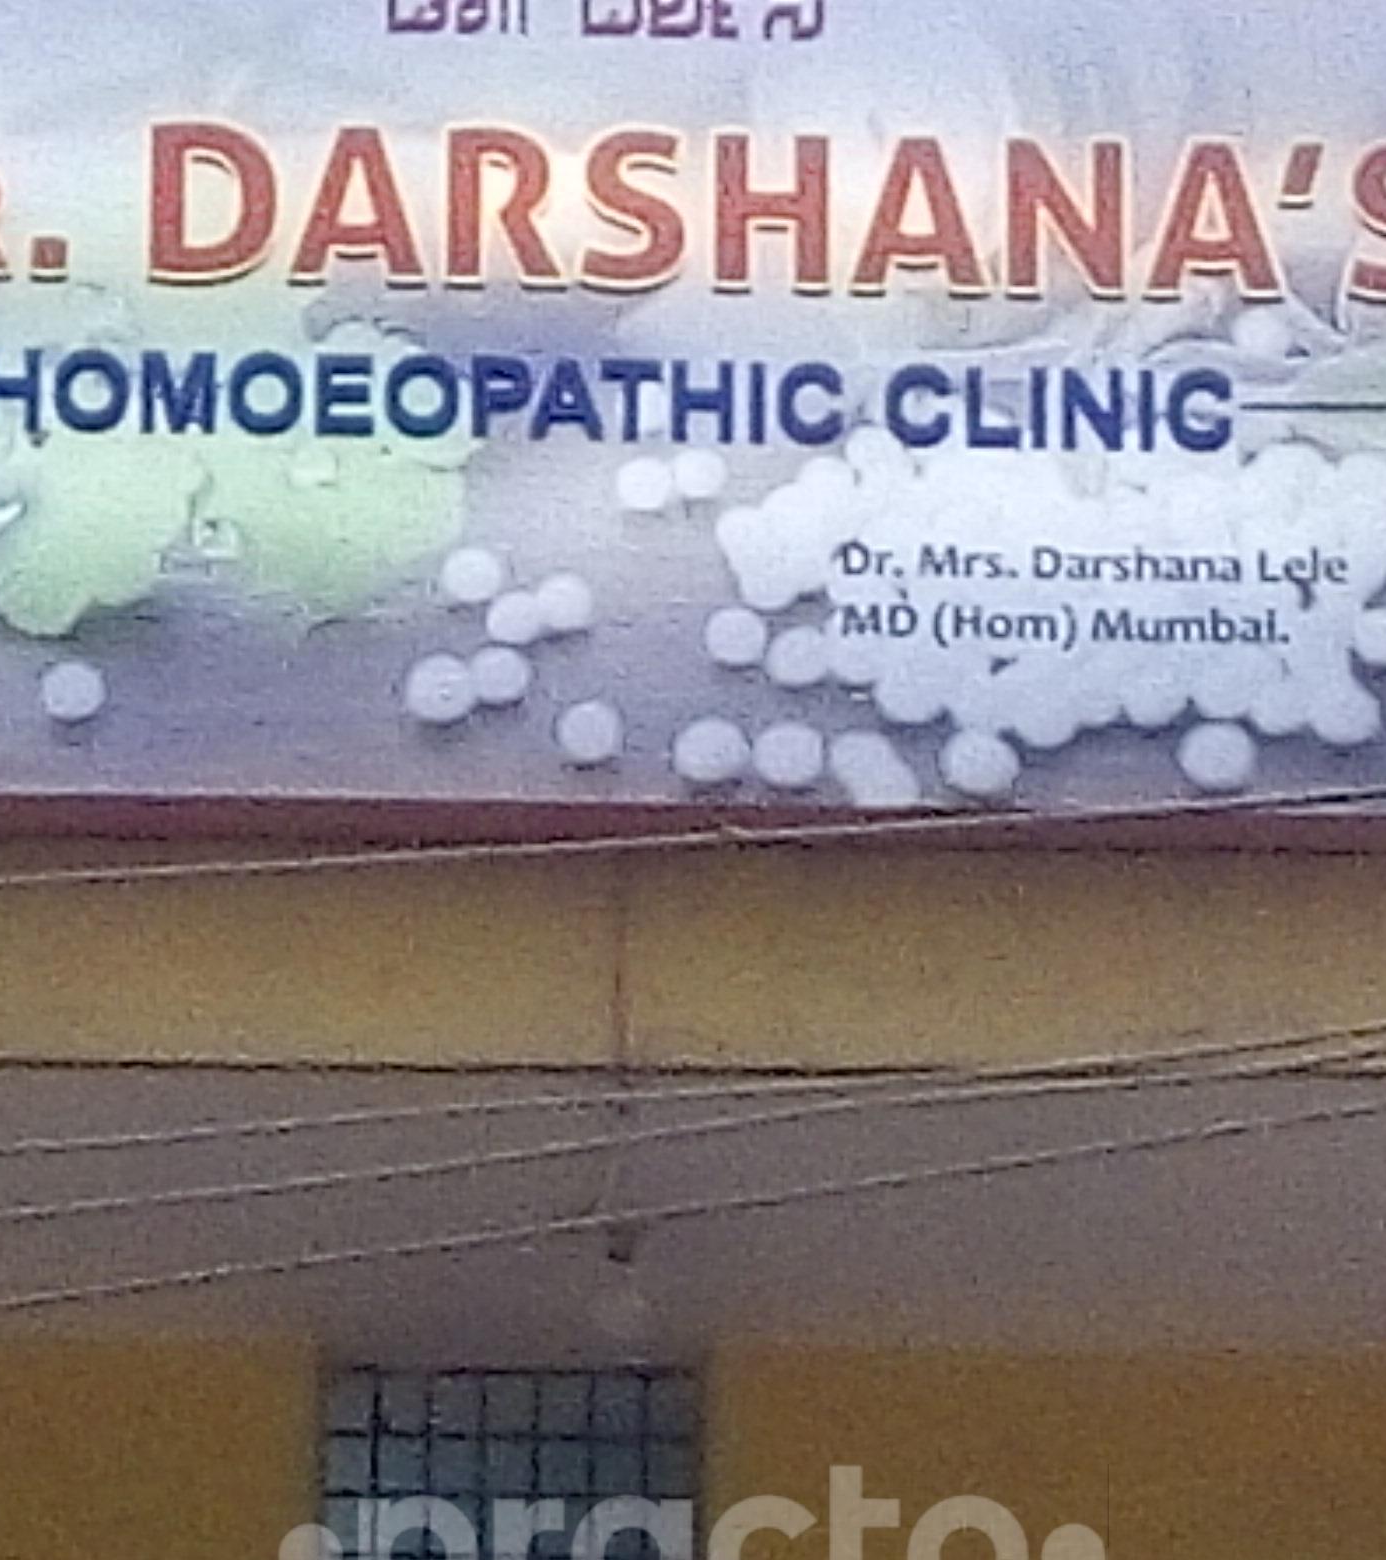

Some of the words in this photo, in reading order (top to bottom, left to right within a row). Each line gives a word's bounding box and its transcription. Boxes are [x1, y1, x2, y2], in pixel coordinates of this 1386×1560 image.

[884, 362, 1233, 453] CLINIC
[839, 540, 905, 578] Dr.
[918, 544, 1019, 580] Mrs.
[1032, 545, 1242, 582] Darshana
[1257, 548, 1349, 584] Lele
[841, 604, 918, 638] MD
[932, 602, 1077, 652] (Hom)
[1091, 608, 1291, 644] Mumbai.
